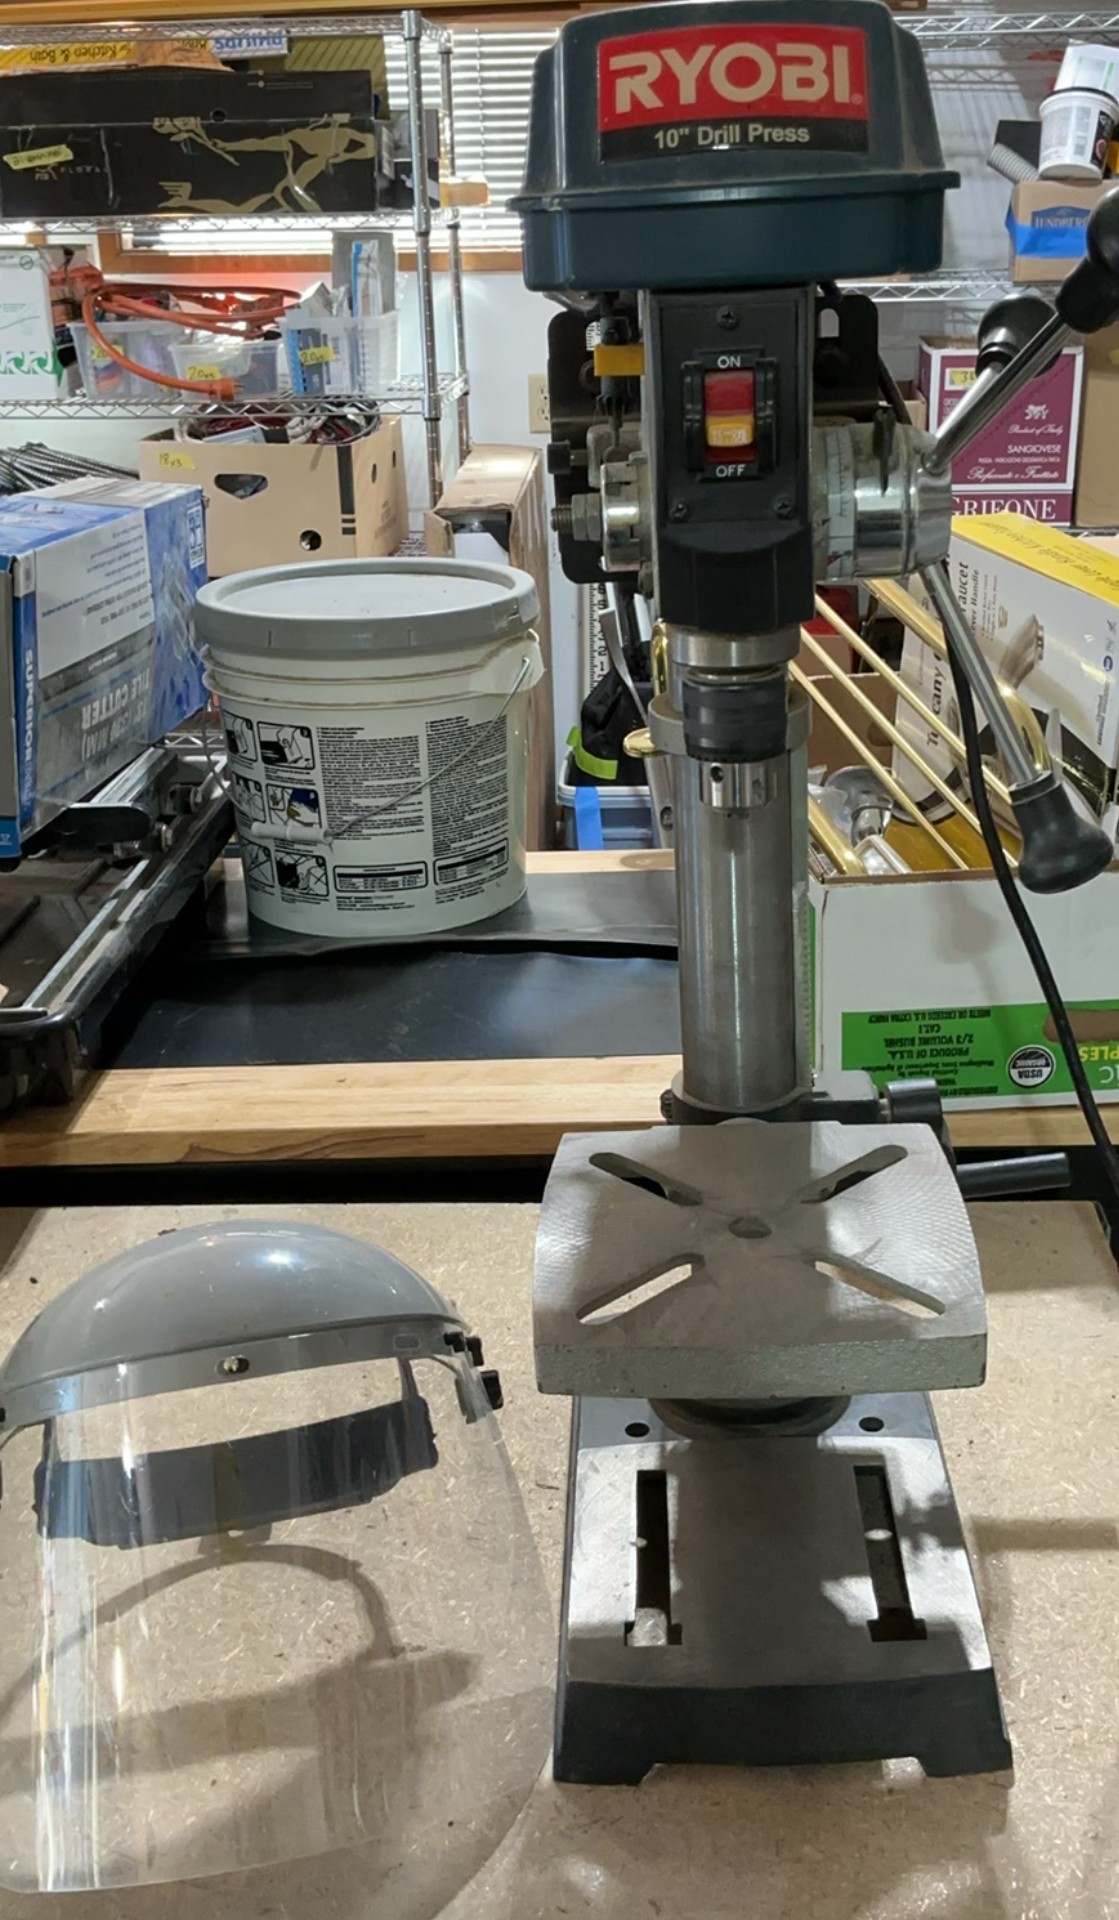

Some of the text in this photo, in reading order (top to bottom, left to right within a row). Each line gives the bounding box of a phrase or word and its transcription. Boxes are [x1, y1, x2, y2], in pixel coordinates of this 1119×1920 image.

[30, 49, 56, 64] Bath
[60, 48, 70, 62] &
[75, 45, 117, 60] Kitchen
[609, 42, 850, 115] RYOBI
[654, 124, 810, 150] 10" Drill Press
[717, 355, 741, 369] ON
[1007, 444, 1062, 454] SANGIOVESE
[715, 464, 746, 478] OFF
[598, 647, 607, 656] 2
[599, 661, 605, 671] 1
[25, 649, 34, 762] SUPERIOR
[81, 684, 129, 730] CUTTER
[926, 666, 946, 747] Tucany
[883, 1033, 974, 1048] 2/3 VOLUME BUSHEL
[888, 1047, 970, 1060] PRODUCE OF U.S.A.
[1017, 1069, 1043, 1079] USDA
